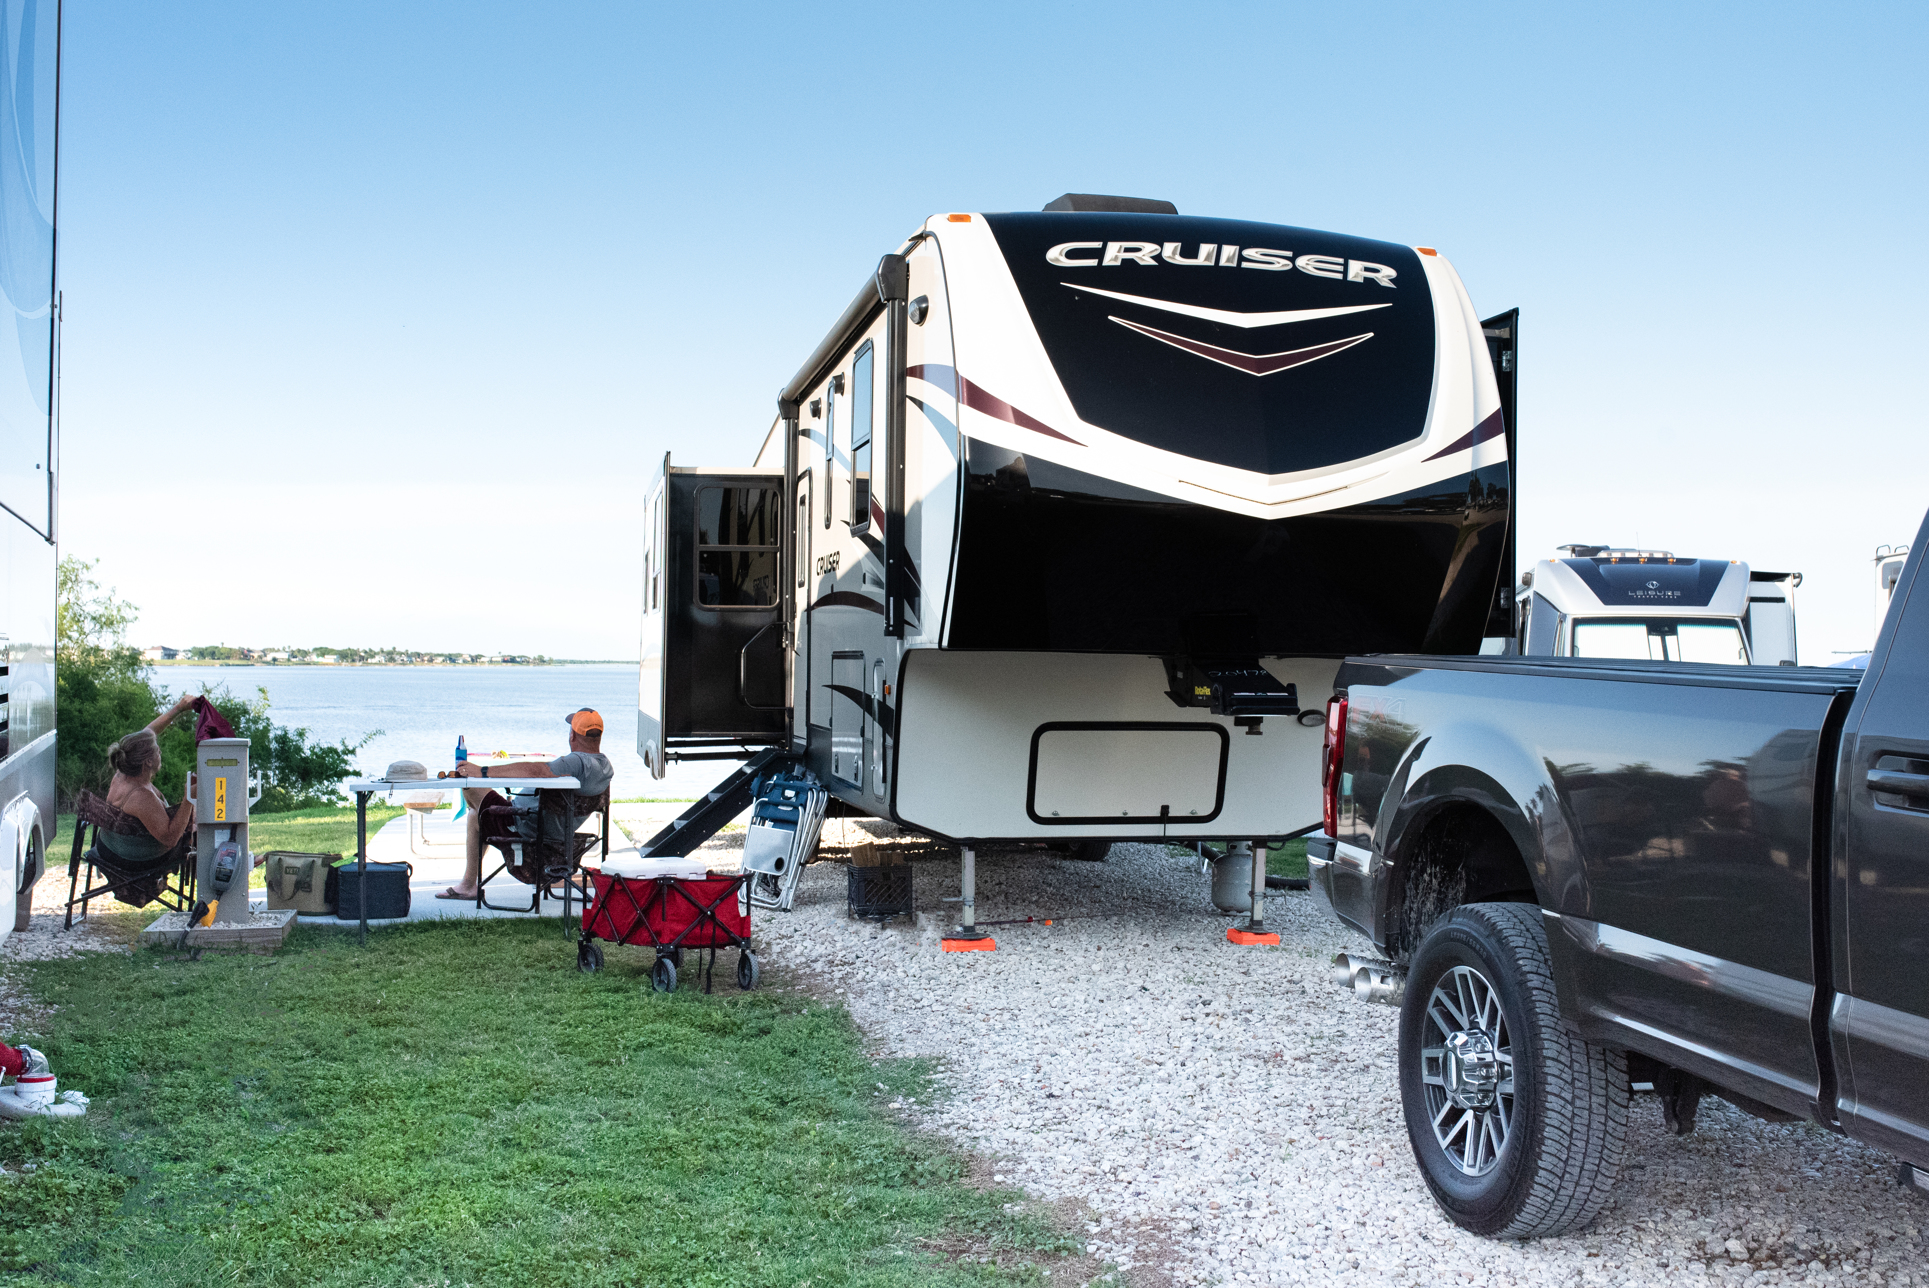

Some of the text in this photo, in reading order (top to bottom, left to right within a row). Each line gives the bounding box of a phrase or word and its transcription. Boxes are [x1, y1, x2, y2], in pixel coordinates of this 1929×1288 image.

[1045, 241, 1398, 289] CRUISER
[816, 550, 840, 576] CRUISER
[1350, 694, 1407, 727] FX4
[216, 780, 225, 819] 142
